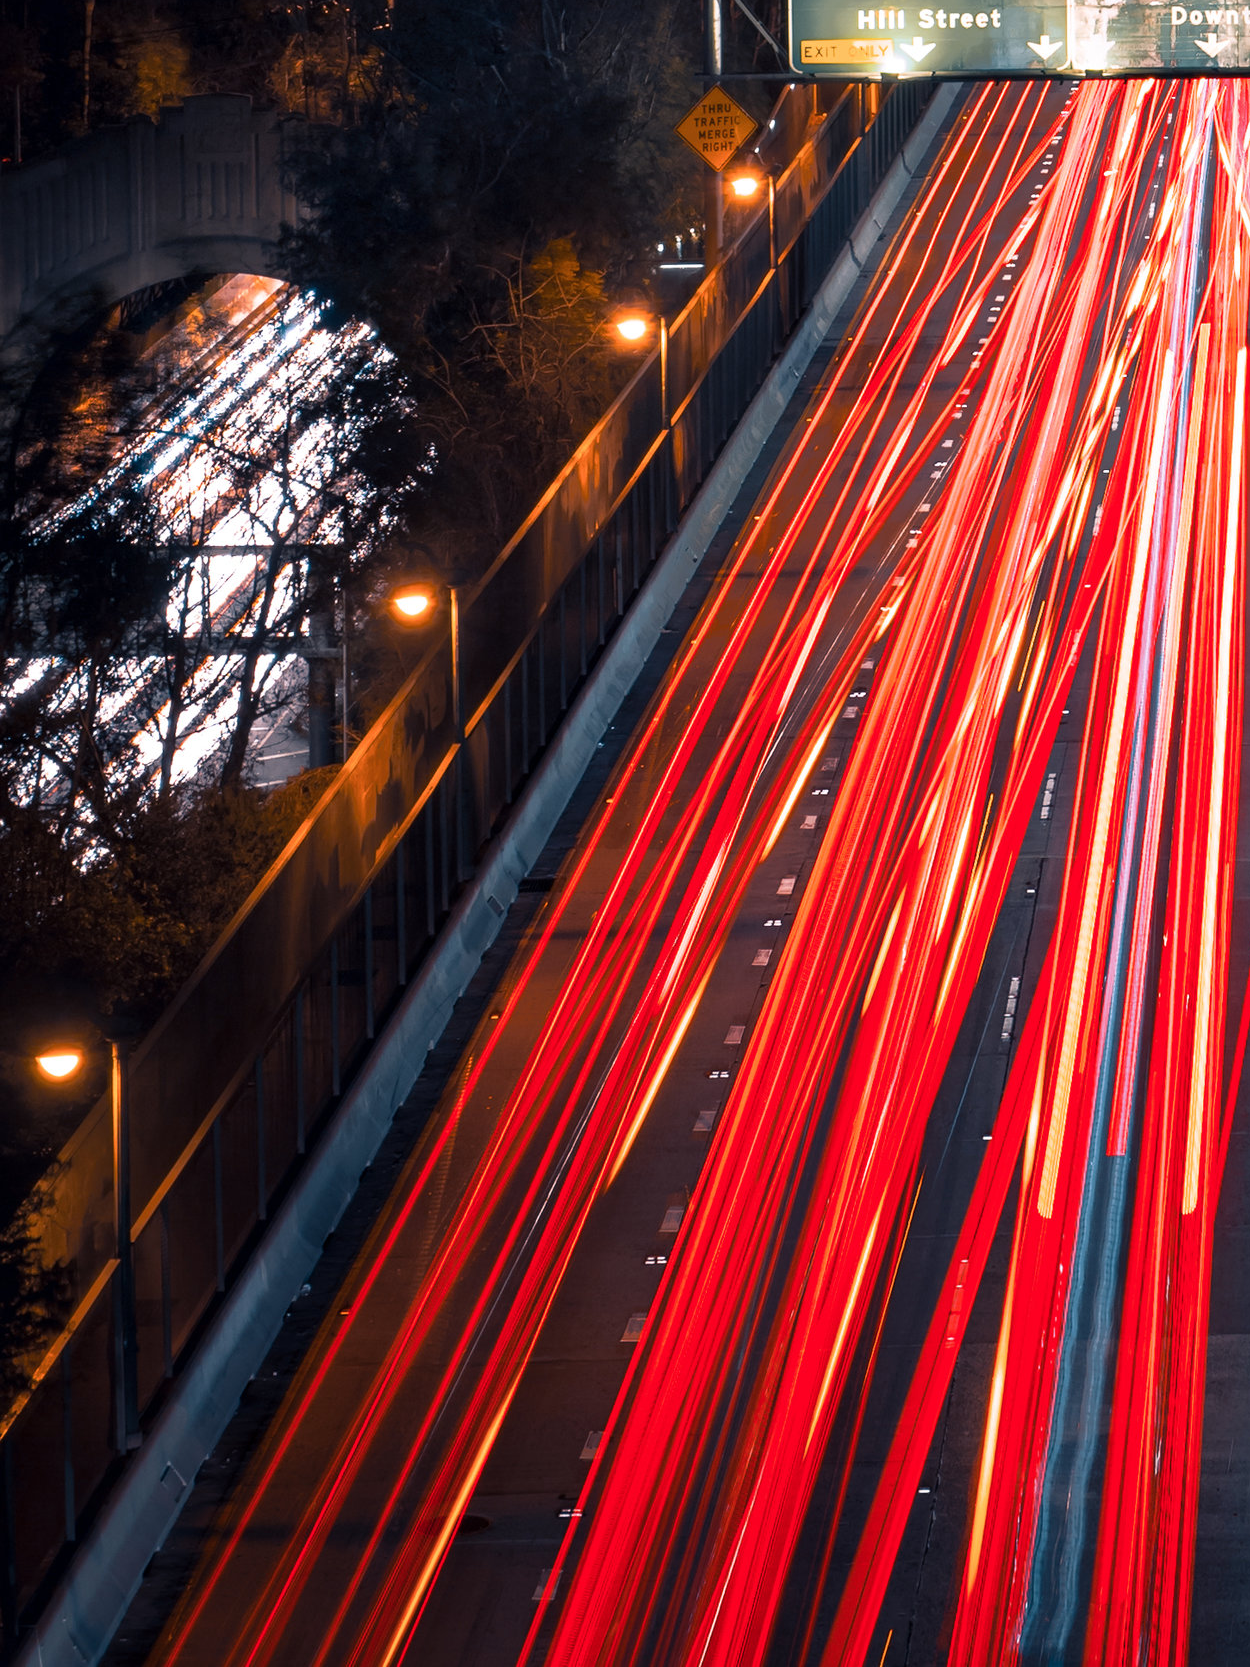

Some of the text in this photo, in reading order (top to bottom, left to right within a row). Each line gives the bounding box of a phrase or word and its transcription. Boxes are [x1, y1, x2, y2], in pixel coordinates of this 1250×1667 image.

[857, 8, 1002, 30] Hill Street
[804, 44, 890, 59] EXIT ONLY
[702, 104, 731, 113] THRU
[694, 116, 740, 127] TRAFFIC
[698, 129, 735, 139] MERGE
[702, 141, 733, 152] RIGHT
